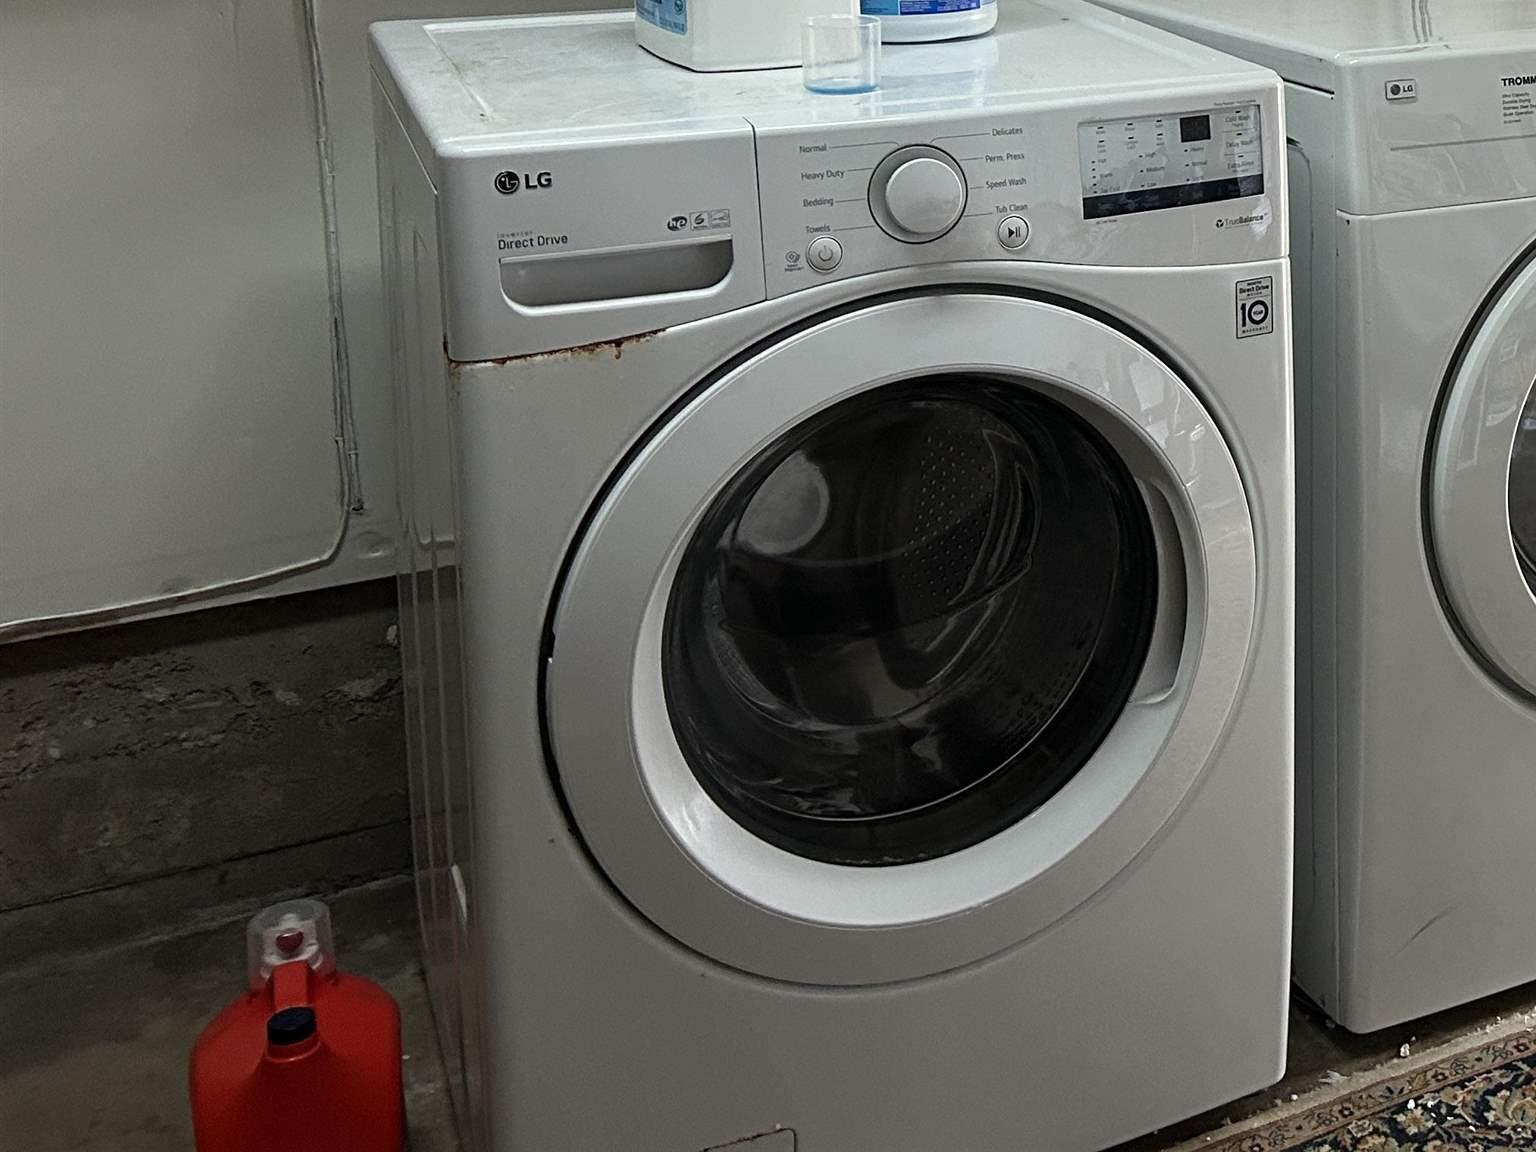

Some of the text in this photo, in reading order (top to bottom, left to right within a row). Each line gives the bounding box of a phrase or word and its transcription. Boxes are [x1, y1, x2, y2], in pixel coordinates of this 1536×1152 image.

[1402, 85, 1414, 93] LG
[992, 127, 1023, 136] Delicates
[800, 143, 828, 153] Normal
[984, 152, 1025, 163] Perm. Press
[801, 169, 845, 180] Heavy Duty
[524, 171, 553, 190] LG
[986, 177, 1027, 190] Speed Wash
[803, 198, 834, 208] Bedding
[995, 203, 1028, 214] Tub Clean
[1224, 214, 1264, 226] TrueBalance
[805, 224, 831, 234] Towels
[498, 233, 568, 250] Direct Drive
[1240, 299, 1269, 327] 10
